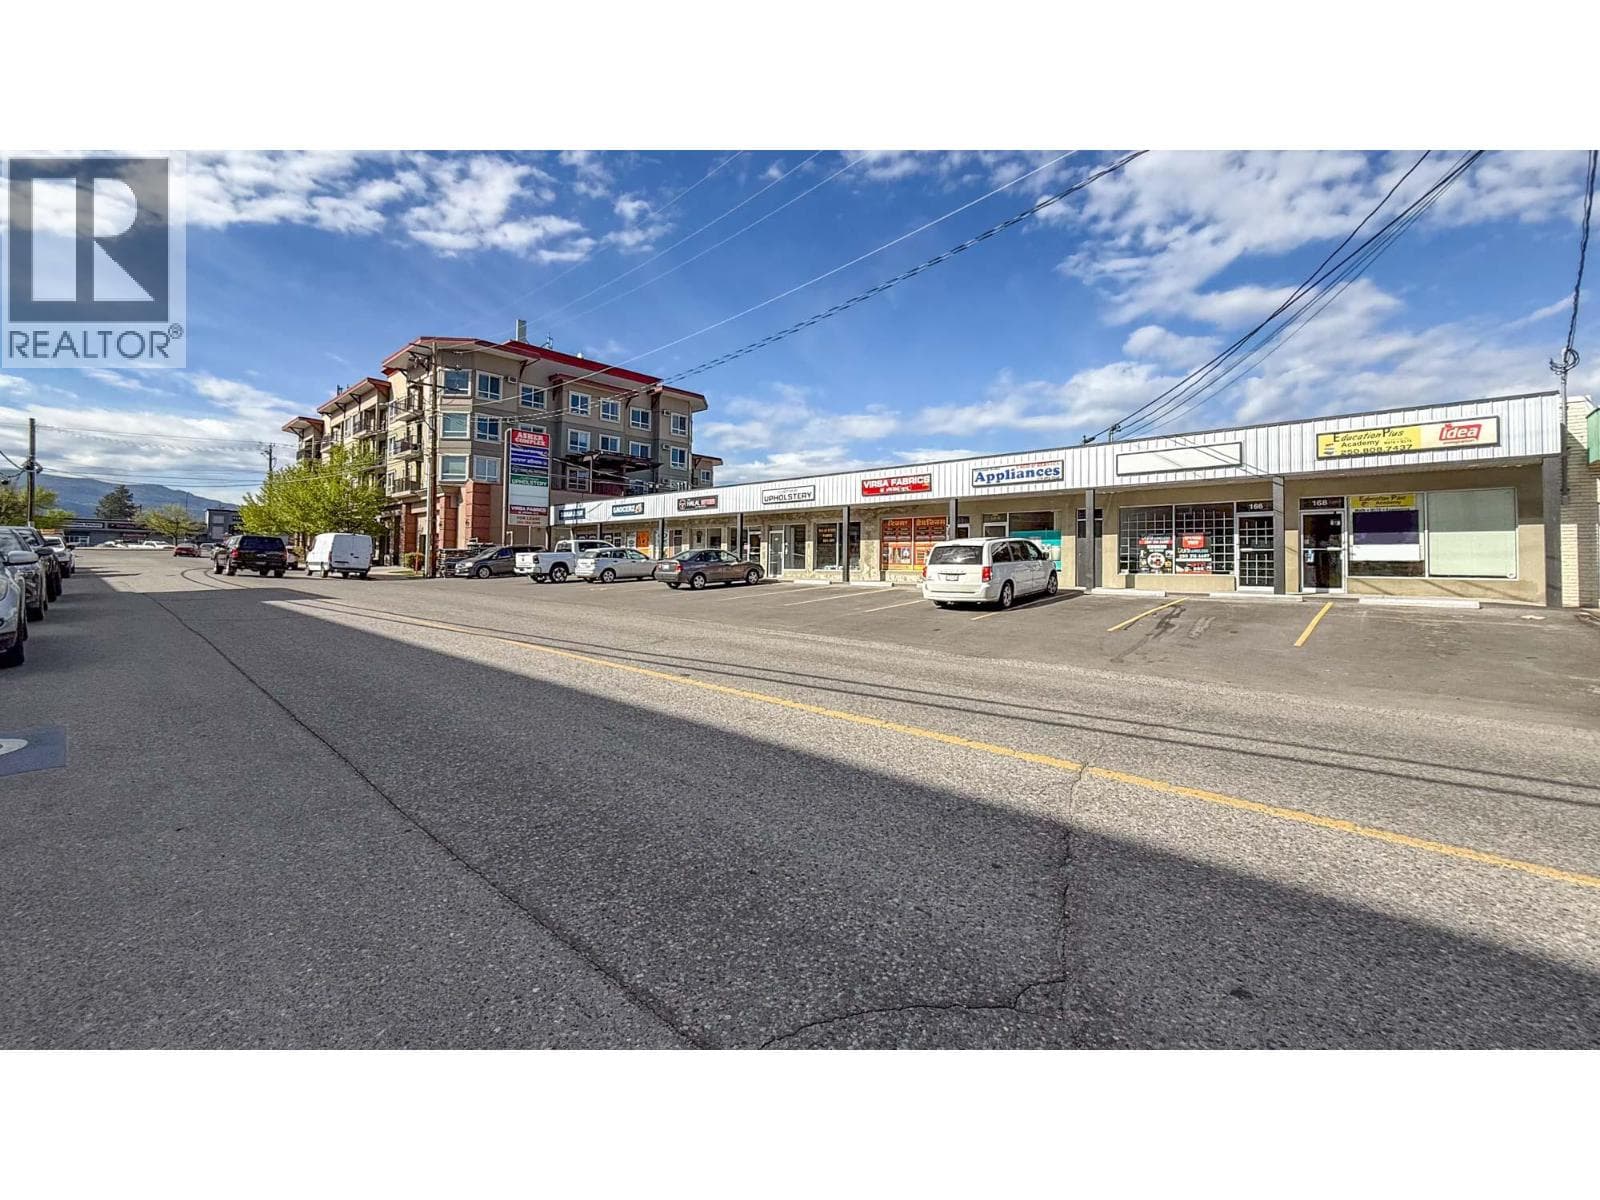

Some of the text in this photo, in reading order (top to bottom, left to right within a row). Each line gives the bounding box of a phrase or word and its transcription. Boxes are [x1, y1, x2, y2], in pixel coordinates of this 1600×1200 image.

[1382, 428, 1405, 438] Plus
[1440, 423, 1480, 440] idea
[1341, 440, 1380, 448] Academy
[974, 466, 1060, 484] Appliances
[863, 475, 930, 489] VIRSA FABRICS
[764, 491, 812, 502] UPHOLSTERY
[1312, 499, 1328, 507] 168
